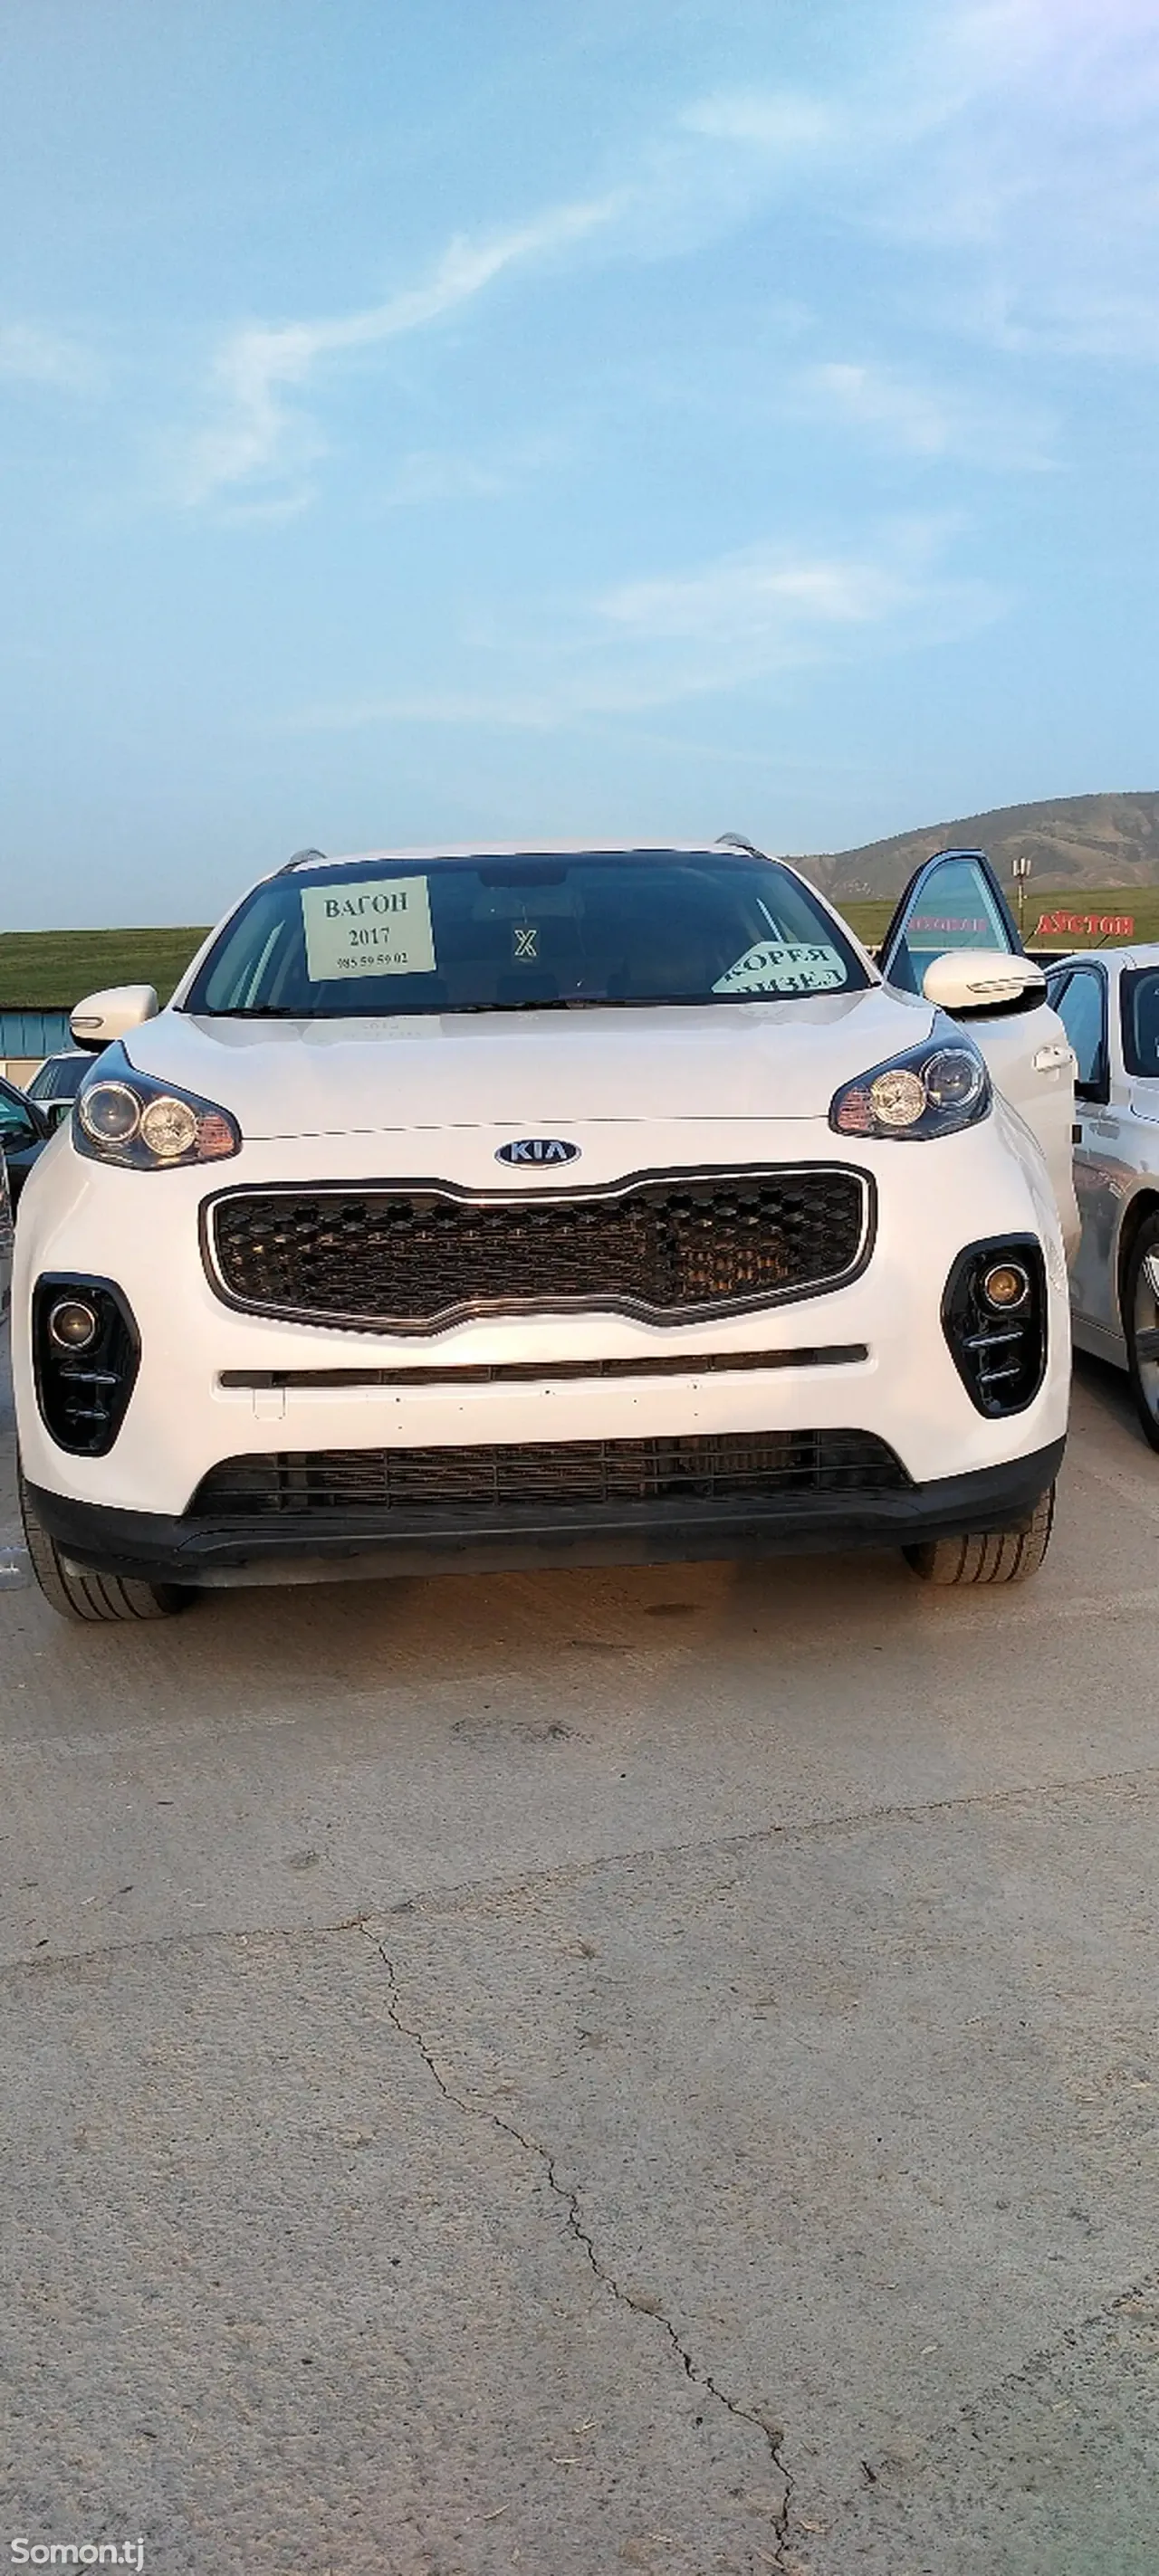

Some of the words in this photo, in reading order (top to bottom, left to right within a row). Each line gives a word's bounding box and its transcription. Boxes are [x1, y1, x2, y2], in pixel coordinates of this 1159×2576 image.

[324, 892, 407, 918] ВАГОН
[349, 927, 389, 946] 2017
[337, 957, 358, 968] 985
[359, 956, 374, 967] 59
[377, 954, 391, 966] 59
[394, 952, 407, 963] 02
[511, 1141, 567, 1160] KIA
